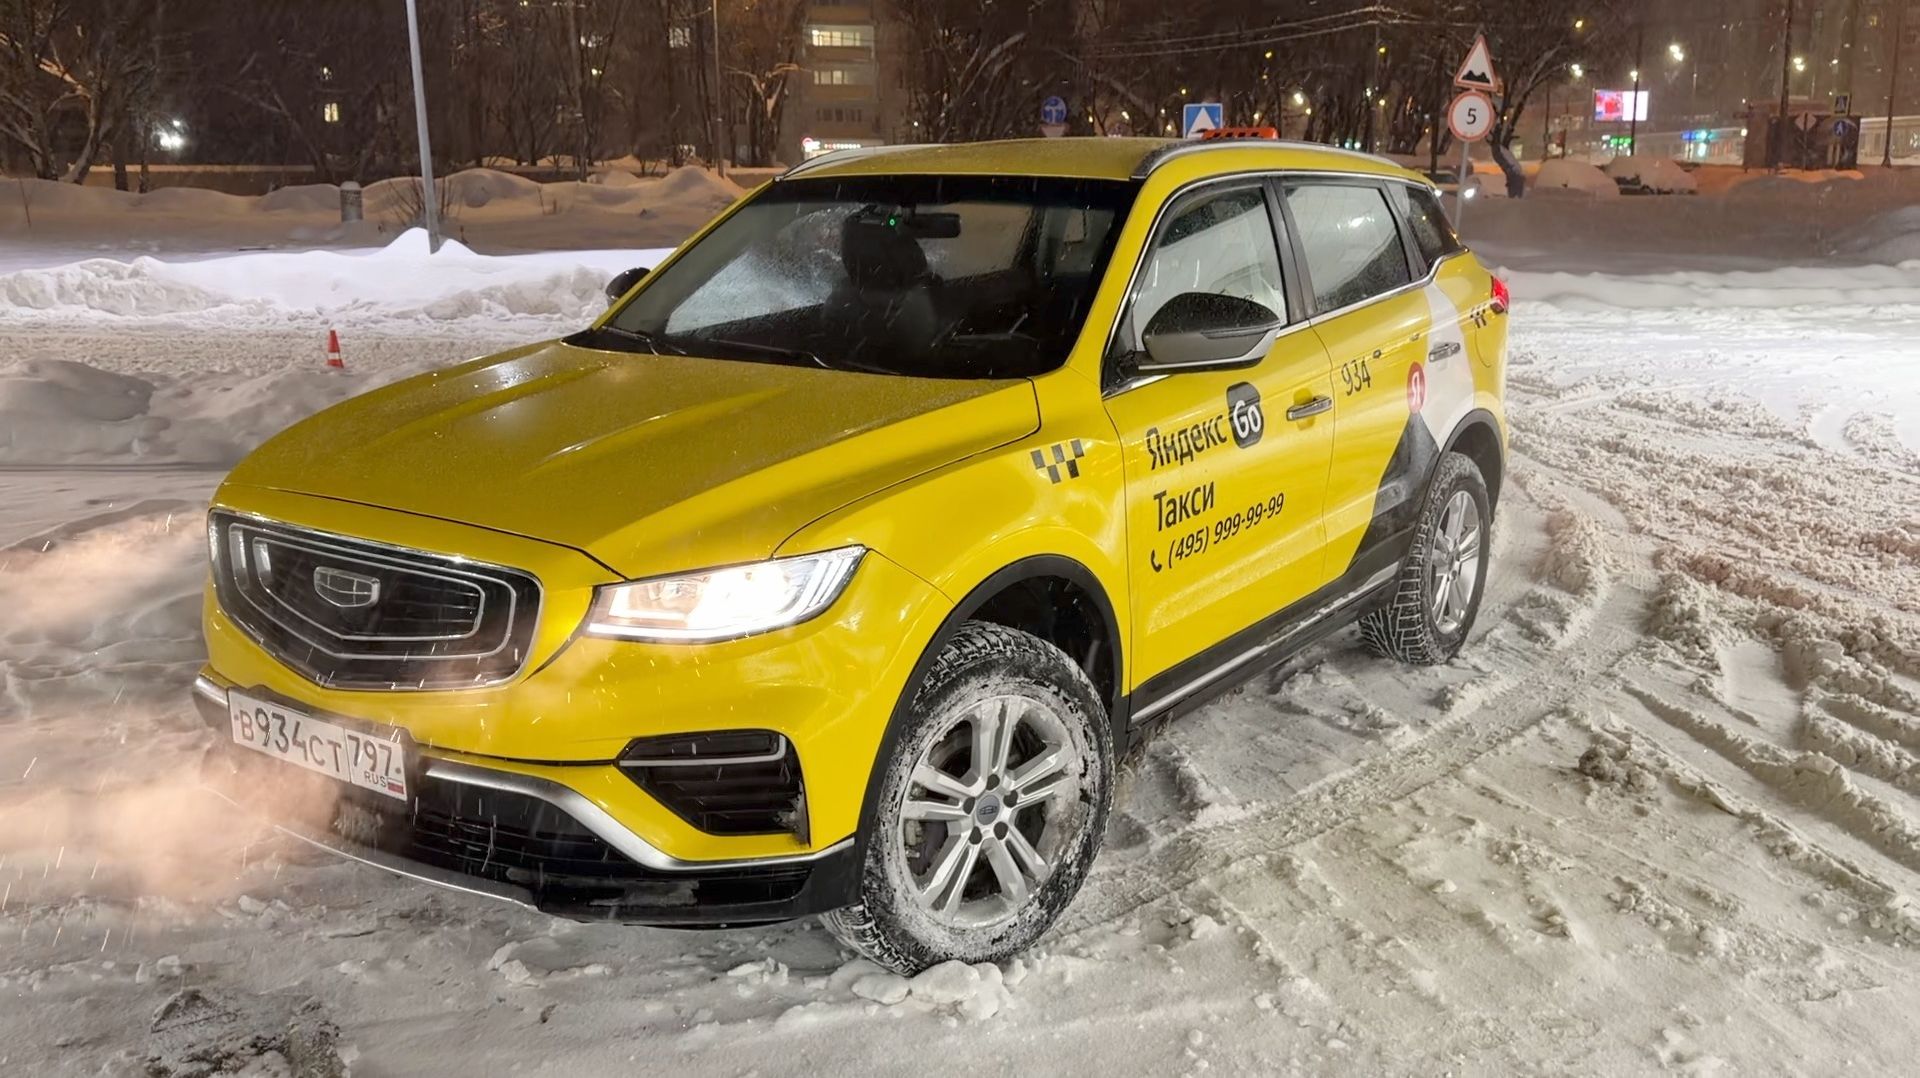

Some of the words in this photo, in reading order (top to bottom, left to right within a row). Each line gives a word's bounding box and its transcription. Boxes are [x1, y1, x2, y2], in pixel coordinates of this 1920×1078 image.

[1466, 107, 1477, 125] 5
[1340, 356, 1371, 396] 934
[1146, 415, 1228, 471] Яндекс
[1233, 399, 1262, 439] Go
[1153, 481, 1215, 532] Такси
[1168, 525, 1209, 569] (495)
[1213, 492, 1285, 545] 999-99-99
[347, 734, 392, 777] 797
[364, 770, 386, 787] RUS
